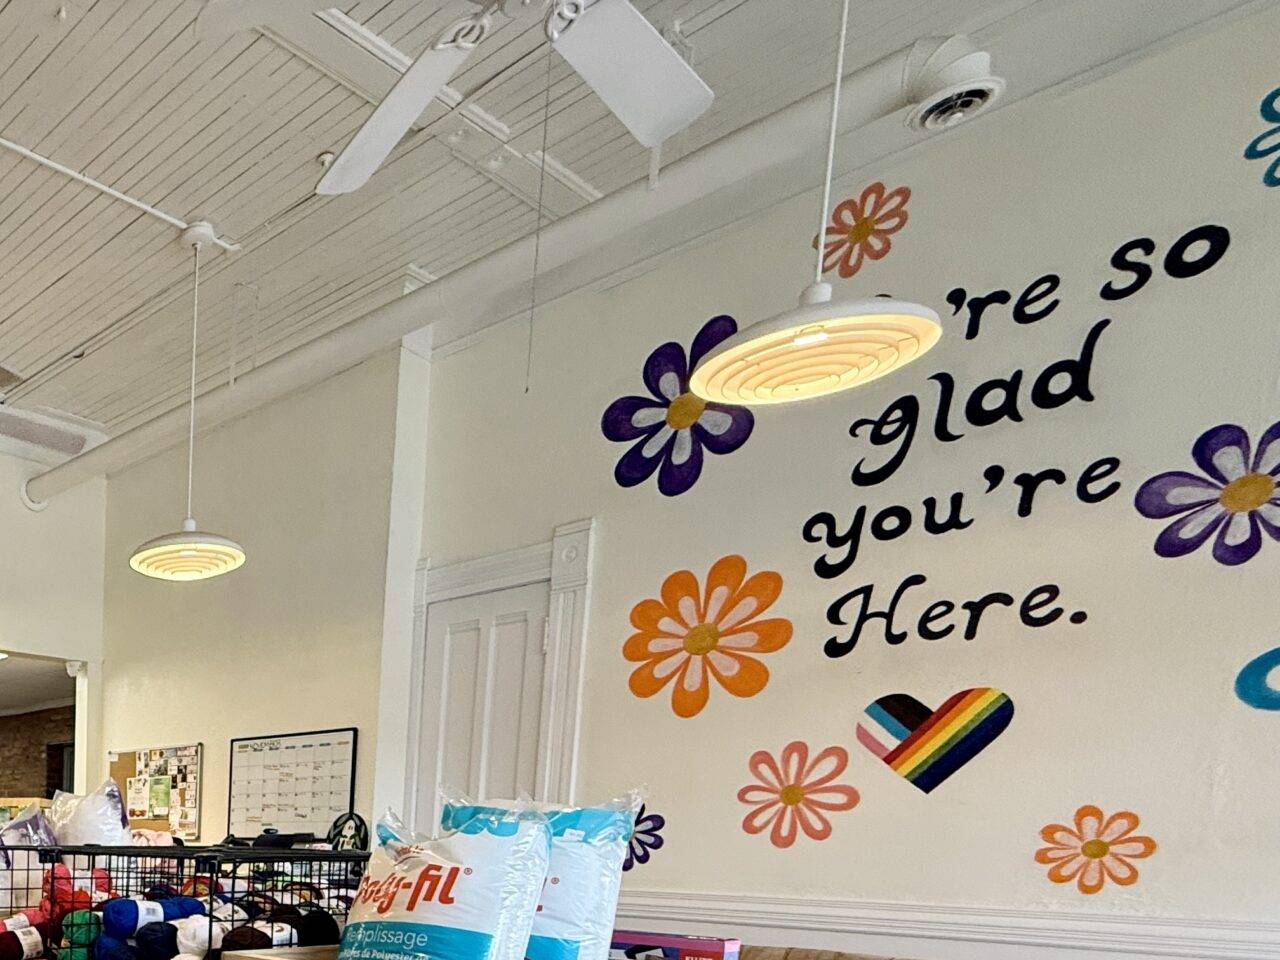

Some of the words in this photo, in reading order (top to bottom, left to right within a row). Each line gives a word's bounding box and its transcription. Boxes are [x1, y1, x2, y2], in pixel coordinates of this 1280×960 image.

[1099, 224, 1231, 301] so
[848, 318, 1113, 487] glad
[802, 456, 1122, 579] you're
[823, 574, 1088, 659] Here.
